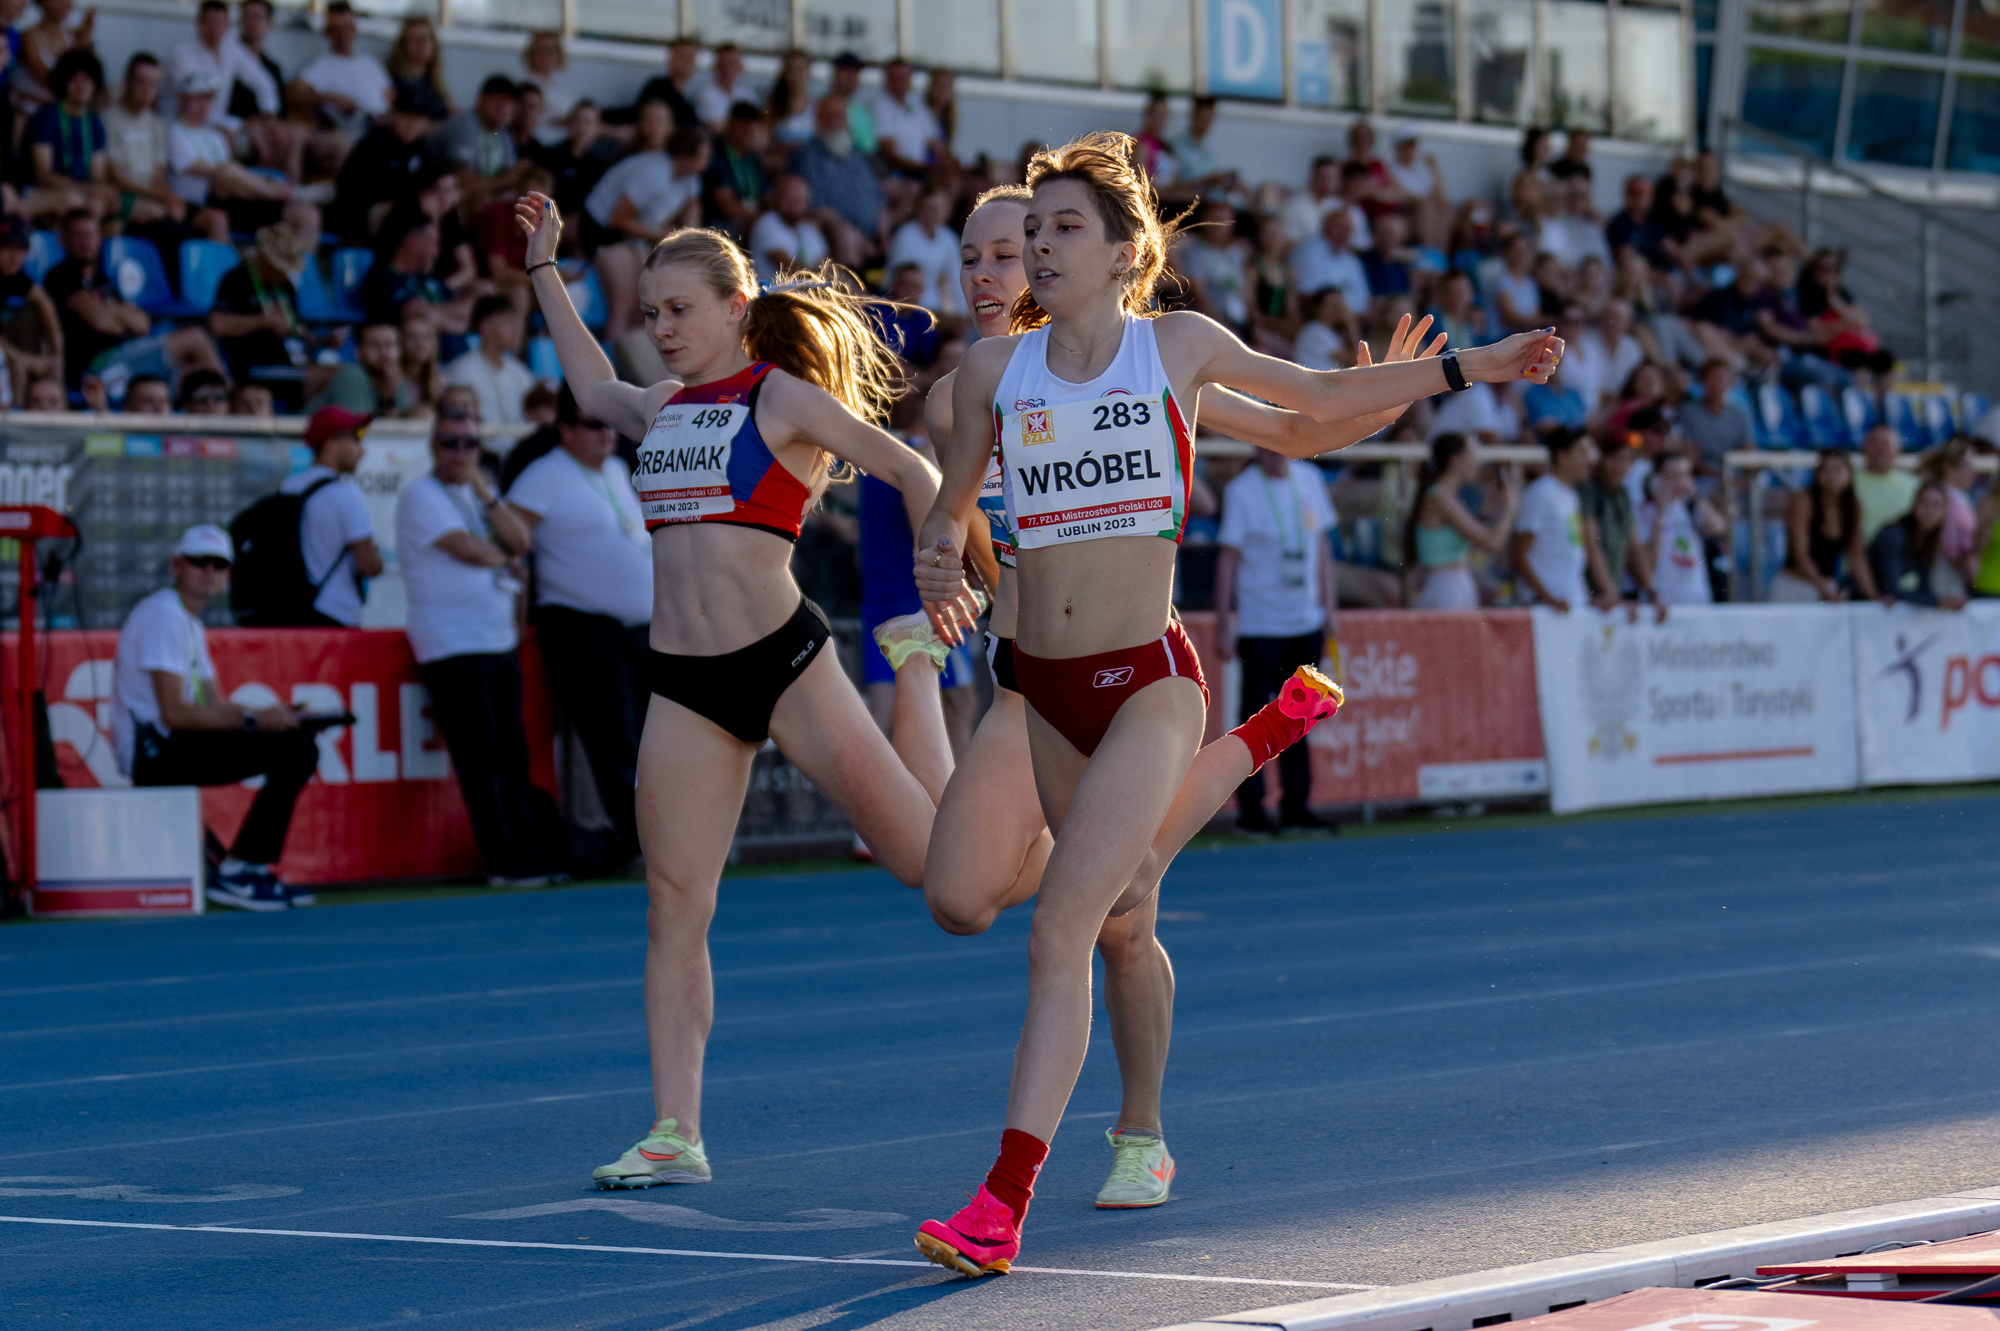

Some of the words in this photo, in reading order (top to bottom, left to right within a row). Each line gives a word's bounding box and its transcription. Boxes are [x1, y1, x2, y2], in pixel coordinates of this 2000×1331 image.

[1223, 0, 1266, 82] D
[691, 409, 732, 428] 498
[1092, 402, 1151, 431] 283
[1024, 432, 1053, 444] PZLA
[1018, 449, 1161, 496] WRÓBEL
[654, 490, 686, 499] Mistrzostwa
[686, 488, 706, 497] Polski
[707, 487, 722, 495] U20
[652, 503, 676, 514] LUBLIN
[677, 501, 700, 512] 2023
[1027, 517, 1040, 526] 77.
[1040, 514, 1061, 524] PZLA
[1062, 506, 1117, 521] Mistrzostwa
[1118, 501, 1146, 513] Polski
[1147, 499, 1163, 509] U20
[1057, 521, 1101, 538] LUBLIN
[1103, 516, 1137, 531] 2023
[791, 640, 814, 667] COLO
